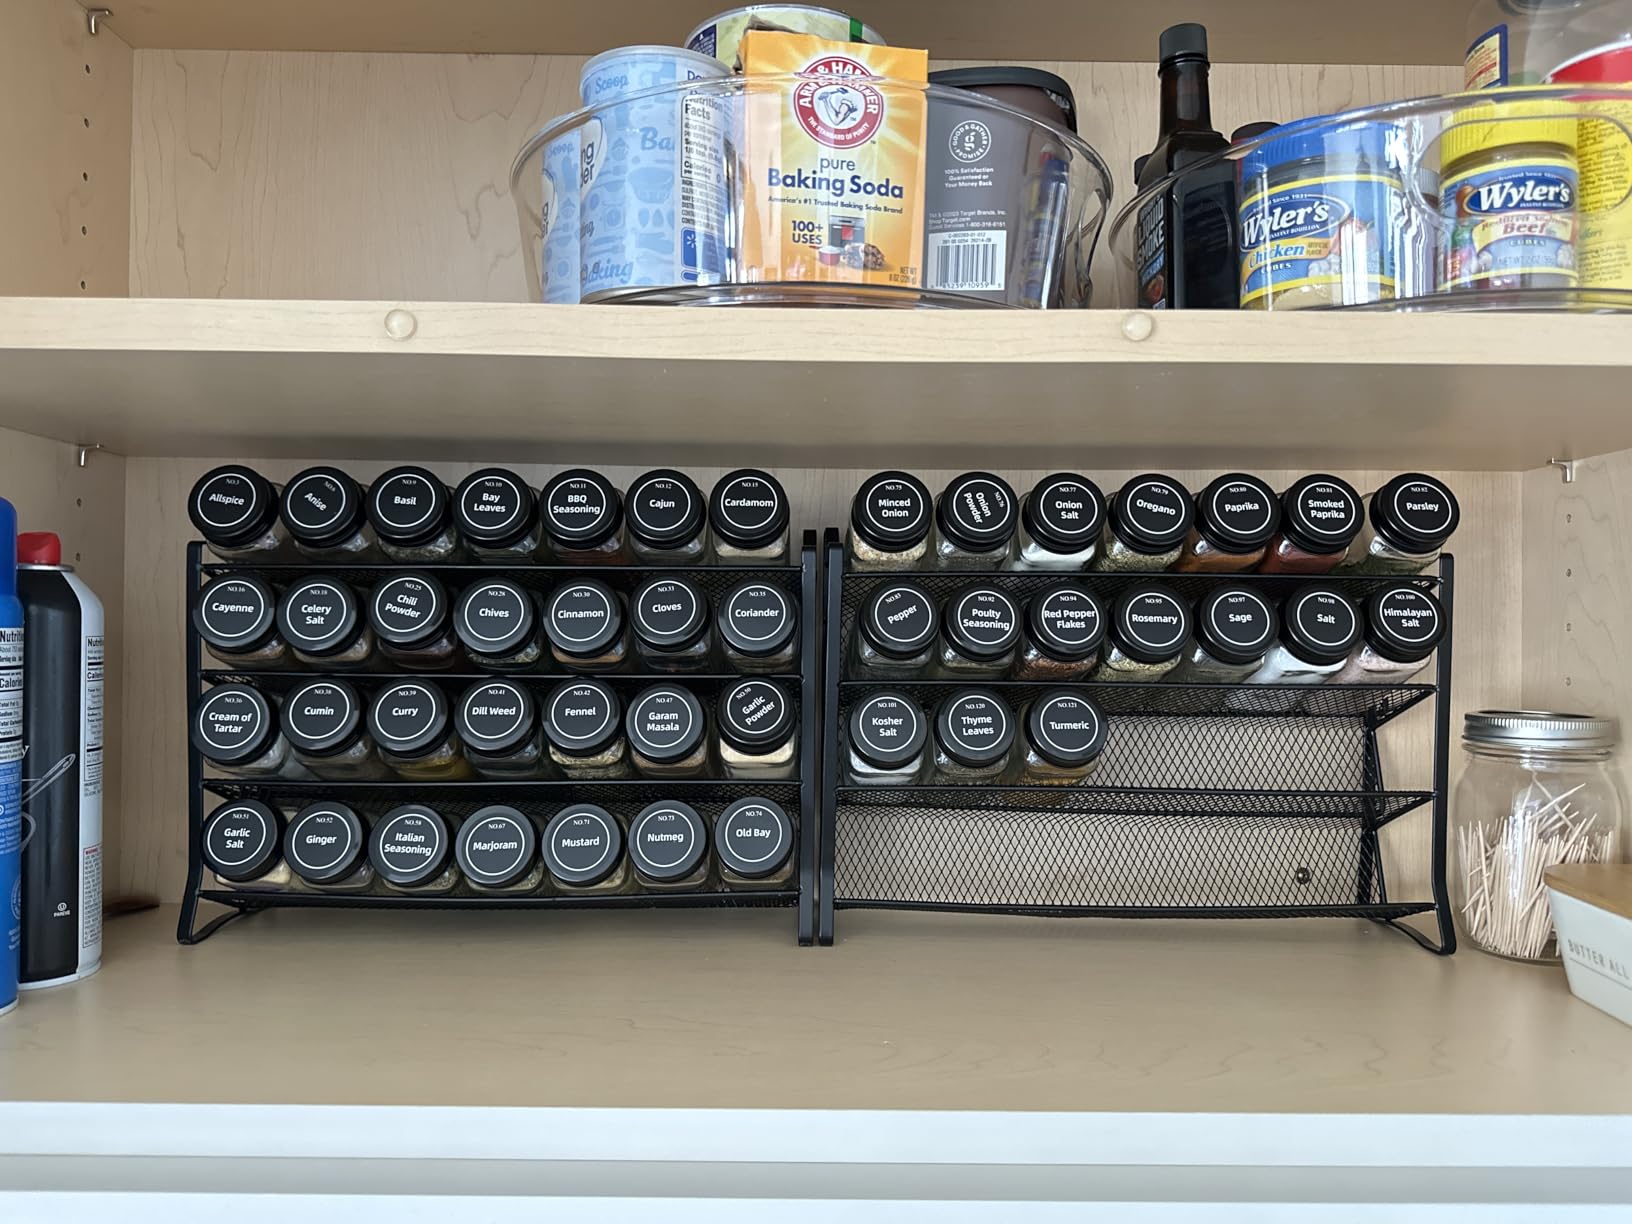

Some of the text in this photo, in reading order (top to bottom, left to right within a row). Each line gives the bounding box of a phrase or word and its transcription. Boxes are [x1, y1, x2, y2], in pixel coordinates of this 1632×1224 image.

[595, 74, 629, 93] Scoop
[685, 104, 711, 120] Facts
[952, 127, 965, 145] GOOD
[970, 124, 988, 145] GATHER
[955, 147, 984, 159] PROMISE
[820, 158, 856, 174] pure
[768, 168, 903, 198] Baking Soda
[1479, 180, 1570, 211] Wyler's
[814, 199, 839, 207] Trusted
[840, 202, 863, 210] Baking
[865, 204, 882, 212] Soda
[884, 206, 903, 214] Brand
[1138, 197, 1164, 242] LIQUID
[1242, 200, 1331, 248] Wyler's
[792, 220, 823, 232] 100+
[1503, 222, 1548, 235] Beef
[792, 233, 822, 245] USES
[1137, 221, 1164, 269] SMOKE
[1249, 242, 1305, 268] Chicken
[1261, 262, 1292, 274] CBES
[208, 493, 245, 506] Allspice
[304, 492, 327, 511] Anise
[394, 495, 417, 505] Basil
[482, 493, 500, 503] Bay
[567, 494, 587, 504] BBQ
[724, 498, 774, 508] Cardamom
[878, 498, 911, 508] Minced
[473, 503, 506, 513] Leaves
[553, 504, 600, 515] Seasoning
[649, 499, 675, 509] Cajun
[963, 492, 983, 524] Powder
[975, 491, 991, 517] Onion
[1055, 500, 1083, 510] Onion
[1137, 499, 1176, 516] Oregano
[1225, 502, 1259, 513] Paprika
[1308, 499, 1345, 509] Smoked
[1406, 501, 1439, 513] Parsley
[882, 508, 909, 518] Onion
[1061, 510, 1079, 520] Salt
[1311, 510, 1345, 519] Paprika
[227, 585, 246, 593] NO.16
[404, 582, 422, 591] NO.25
[397, 594, 417, 605] Chili
[212, 602, 255, 614] Cayenne
[301, 604, 332, 616] Celery
[385, 603, 421, 619] Powder
[479, 608, 510, 618] Chives
[652, 602, 682, 613] Cloves
[735, 608, 779, 618] Coriander
[557, 609, 604, 618] Cinnamon
[887, 604, 918, 624] Pepper
[972, 609, 1001, 620] Poulty
[1044, 609, 1095, 620] Red Pepper
[1132, 613, 1178, 625] Rosemary
[1228, 613, 1252, 624] Sage
[1317, 614, 1335, 624] Salt
[1384, 608, 1433, 619] Himalayan
[305, 616, 325, 625] Salt
[963, 619, 1010, 631] Seasoning
[1056, 619, 1086, 629] Flakes
[1401, 619, 1420, 627] Salt
[741, 695, 766, 715] Garlic
[304, 706, 334, 716] Cumin
[392, 706, 418, 717] Curry
[472, 706, 516, 716] Dill Weed
[565, 707, 596, 716] Fennel
[648, 711, 679, 721] Garam
[745, 700, 776, 726] Powder
[209, 712, 252, 722] Cream of
[872, 717, 903, 726] Kosher
[961, 715, 992, 727] Thyme
[214, 724, 243, 733] Tartar
[647, 722, 680, 732] Masala
[962, 725, 994, 735] Leaves
[1049, 721, 1090, 730] Turmeric
[879, 727, 897, 737] Salt
[224, 828, 251, 838] Garlic
[395, 832, 425, 842] Italian
[647, 833, 684, 844] Nutmeg
[736, 828, 771, 839] Old Bay
[226, 839, 244, 849] Salt
[306, 834, 337, 845] Ginger
[561, 836, 600, 848] Mustard
[384, 843, 432, 856] Seasoning
[472, 840, 518, 852] Marjoram
[1568, 938, 1630, 980] BUTTER ALL
